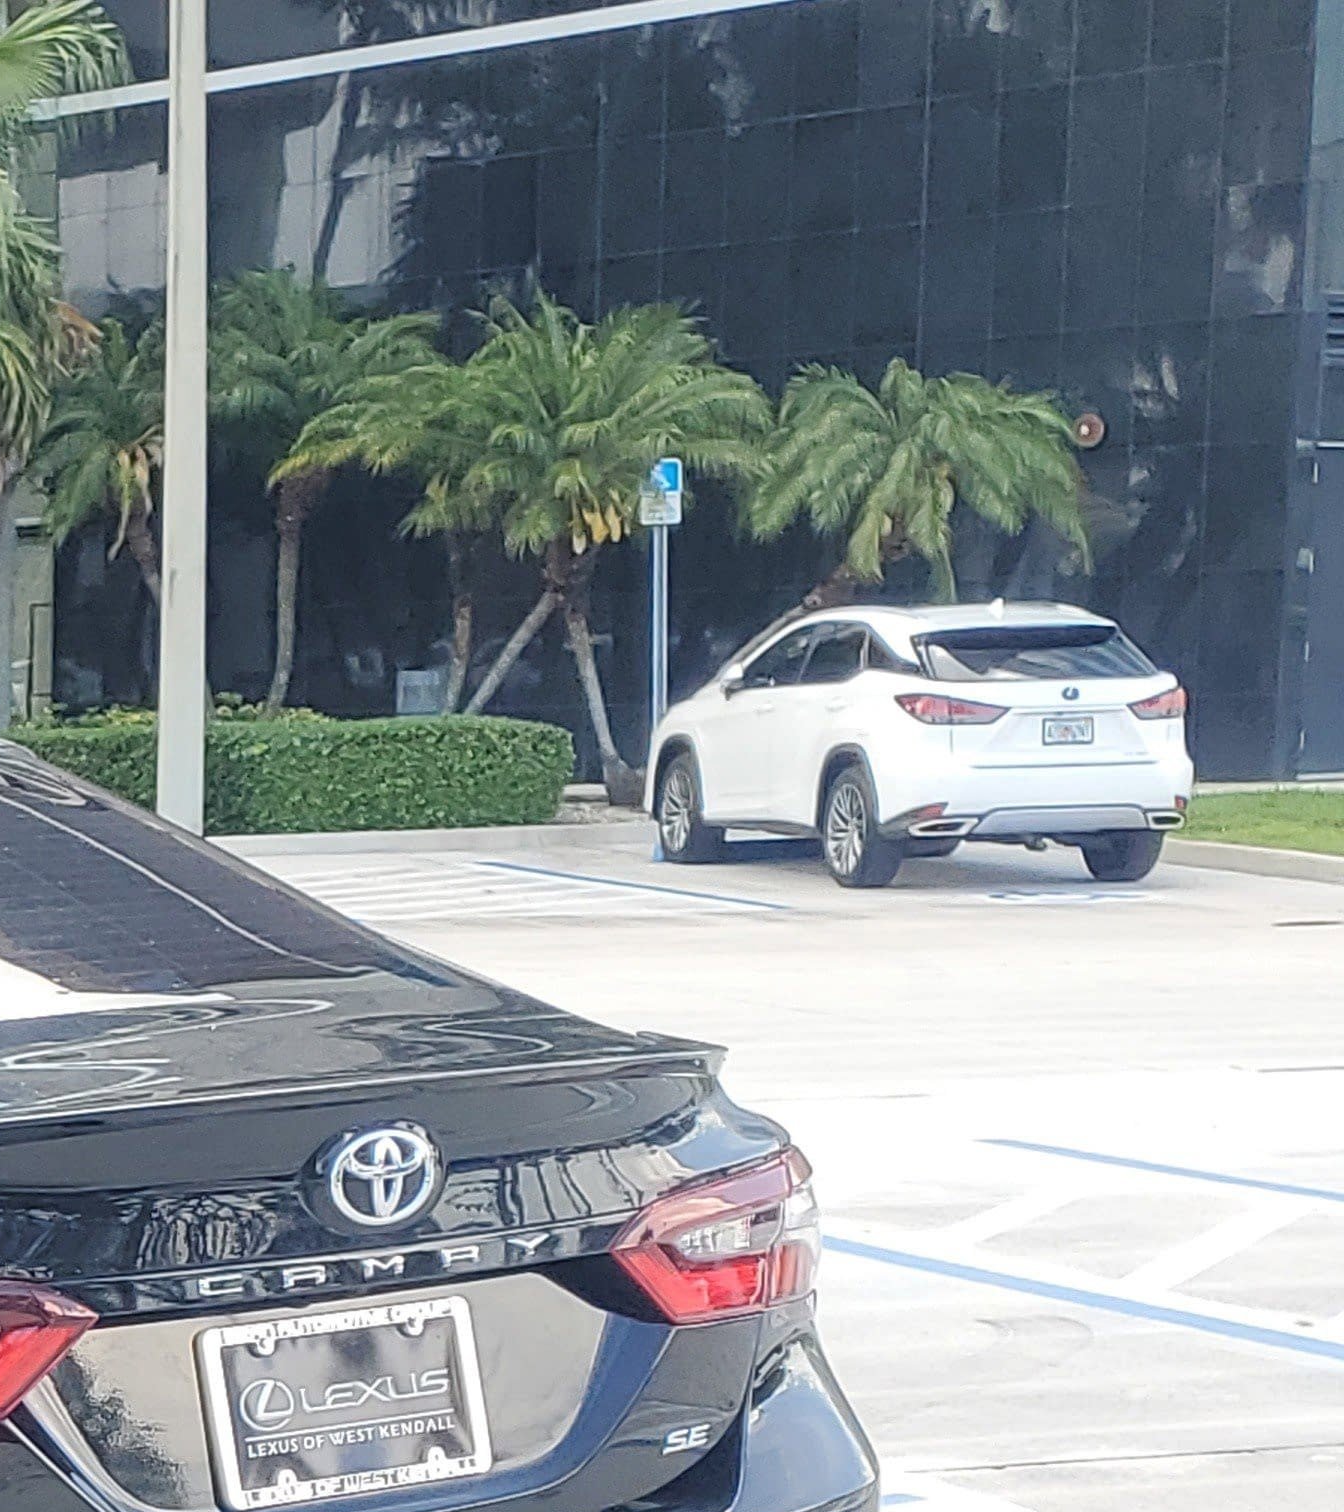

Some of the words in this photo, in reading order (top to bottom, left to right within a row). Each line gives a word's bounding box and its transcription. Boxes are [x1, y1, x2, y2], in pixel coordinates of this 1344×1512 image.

[198, 1233, 550, 1297] CAMRY
[299, 1368, 449, 1413] LEXUS
[247, 1438, 299, 1459] LEXUS
[303, 1434, 325, 1450] OF
[329, 1426, 376, 1446] WEST
[379, 1416, 455, 1439] KENDALL
[662, 1423, 711, 1456] SE
